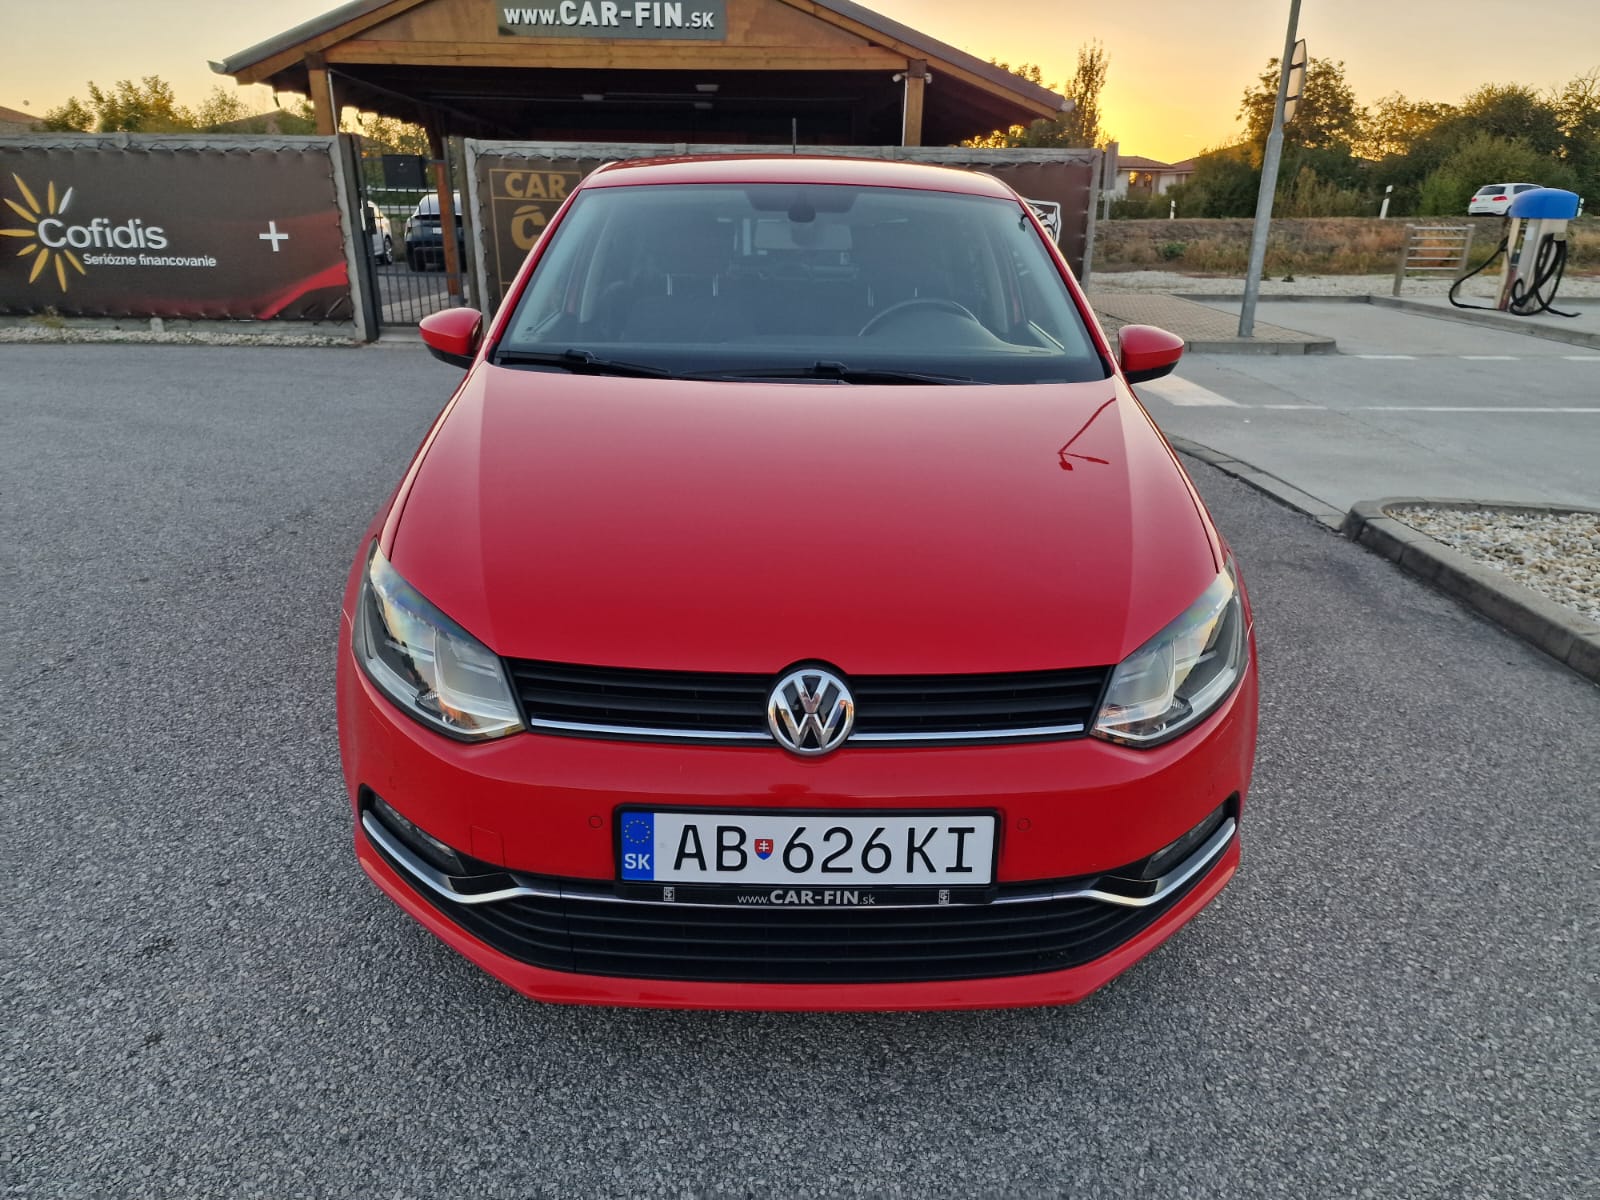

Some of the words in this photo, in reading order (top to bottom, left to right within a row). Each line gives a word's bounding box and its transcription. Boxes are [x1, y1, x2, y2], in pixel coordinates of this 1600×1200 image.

[505, 172, 567, 198] CAR
[38, 218, 168, 249] Cofidis
[83, 253, 137, 266] Seriózne
[138, 254, 217, 267] financovanie
[673, 824, 748, 872] AB
[624, 853, 651, 870] SK
[737, 889, 876, 905] www.CAR-FIN.sk
